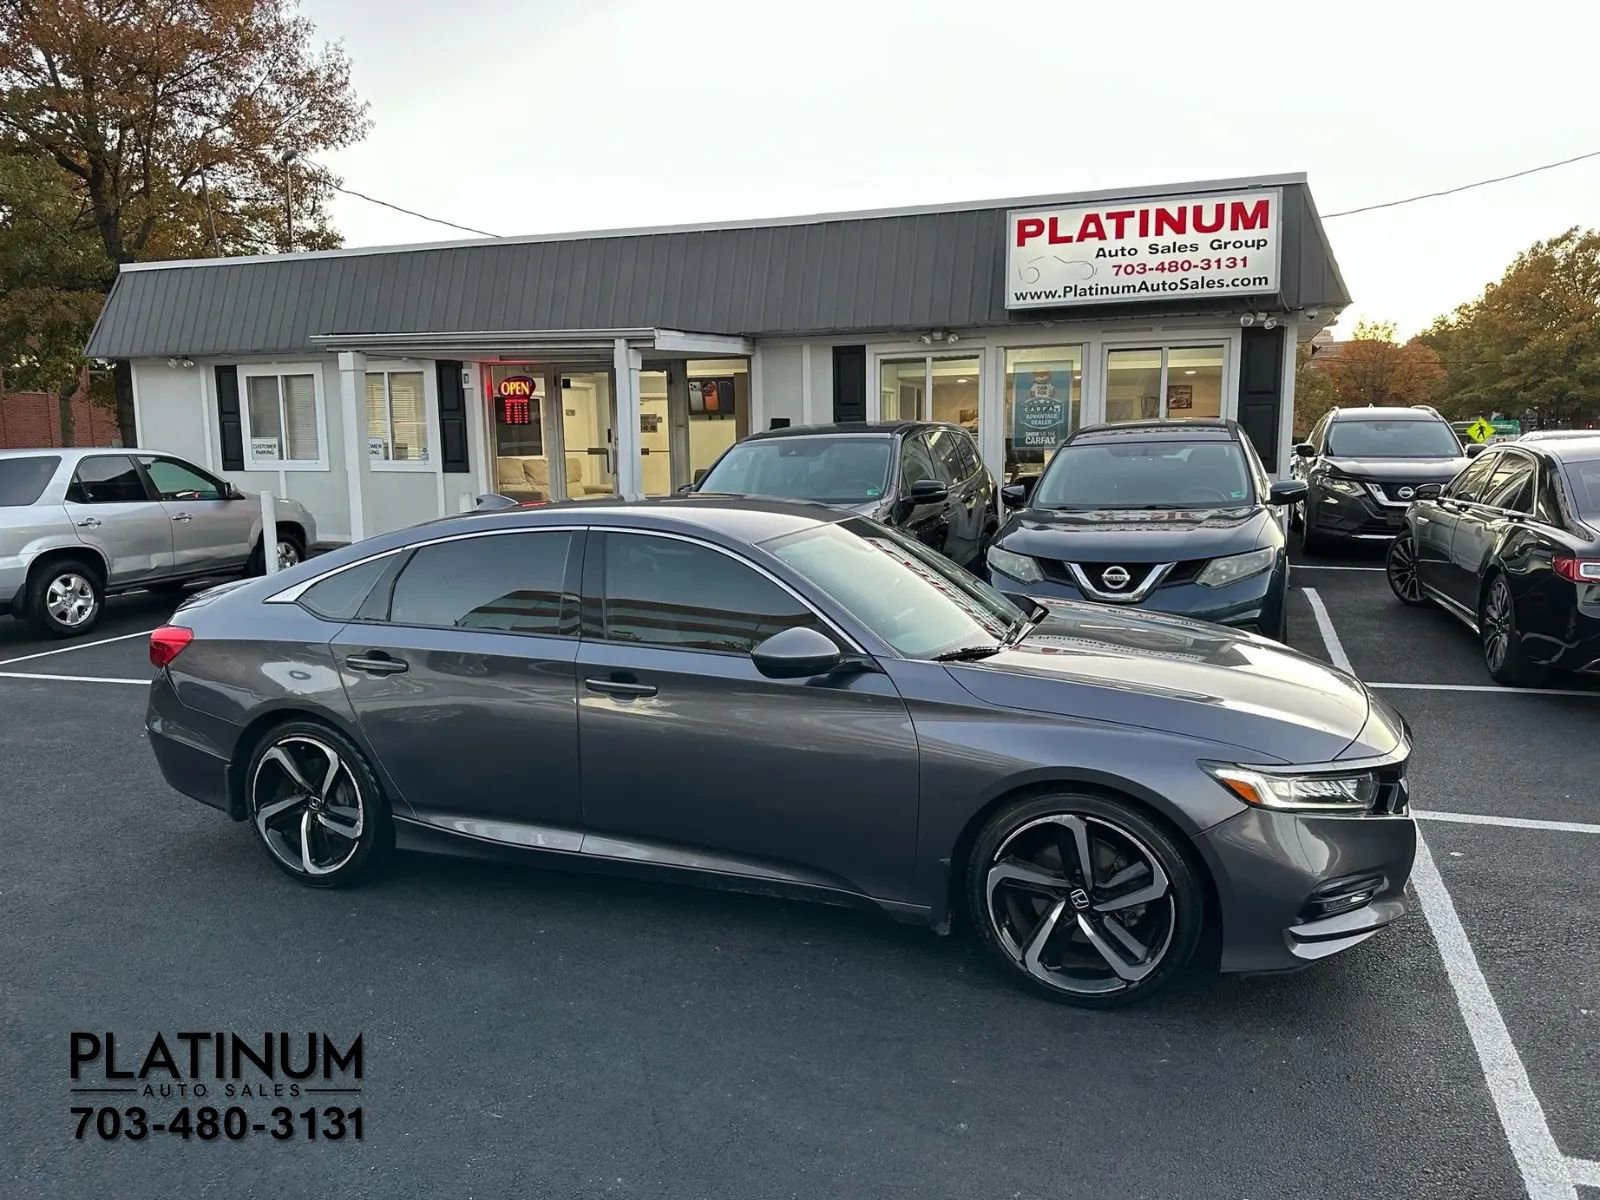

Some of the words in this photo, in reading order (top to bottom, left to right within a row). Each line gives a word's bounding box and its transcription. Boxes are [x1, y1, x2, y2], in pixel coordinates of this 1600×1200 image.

[1016, 199, 1270, 247] PLATINUM
[1095, 246, 1138, 259] Auto
[1148, 241, 1199, 255] Sales
[1209, 237, 1268, 251] Group
[1112, 256, 1248, 277] 703-480-3131
[1014, 274, 1269, 301] www.PlatinumAutoSales.com
[500, 381, 530, 395] OPEN
[1025, 436, 1056, 444] CARFAX
